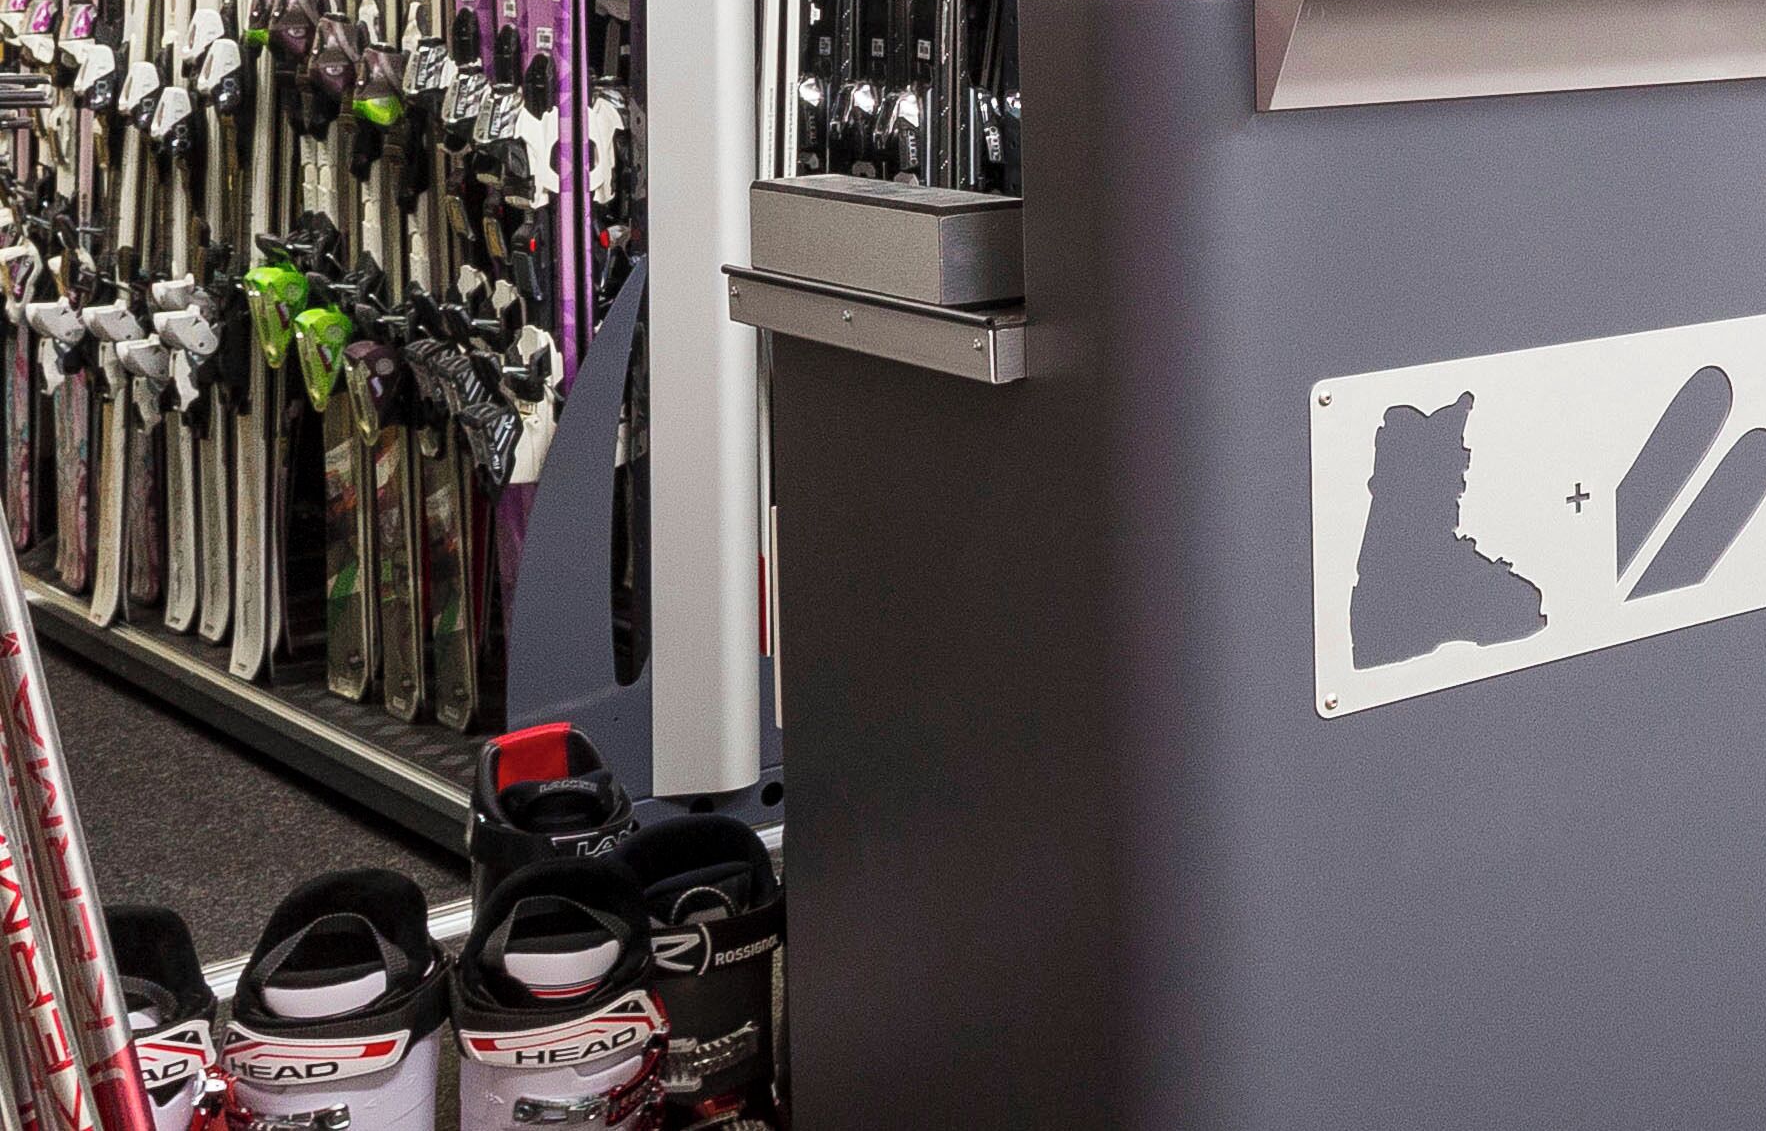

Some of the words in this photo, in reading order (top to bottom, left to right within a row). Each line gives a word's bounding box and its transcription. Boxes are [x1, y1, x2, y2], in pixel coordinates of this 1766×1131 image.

[13, 672, 116, 1032] KERMA
[0, 832, 96, 1131] KERM
[516, 1026, 638, 1066] HEAD
[142, 1058, 190, 1083] AD
[229, 1057, 340, 1081] HEAD
